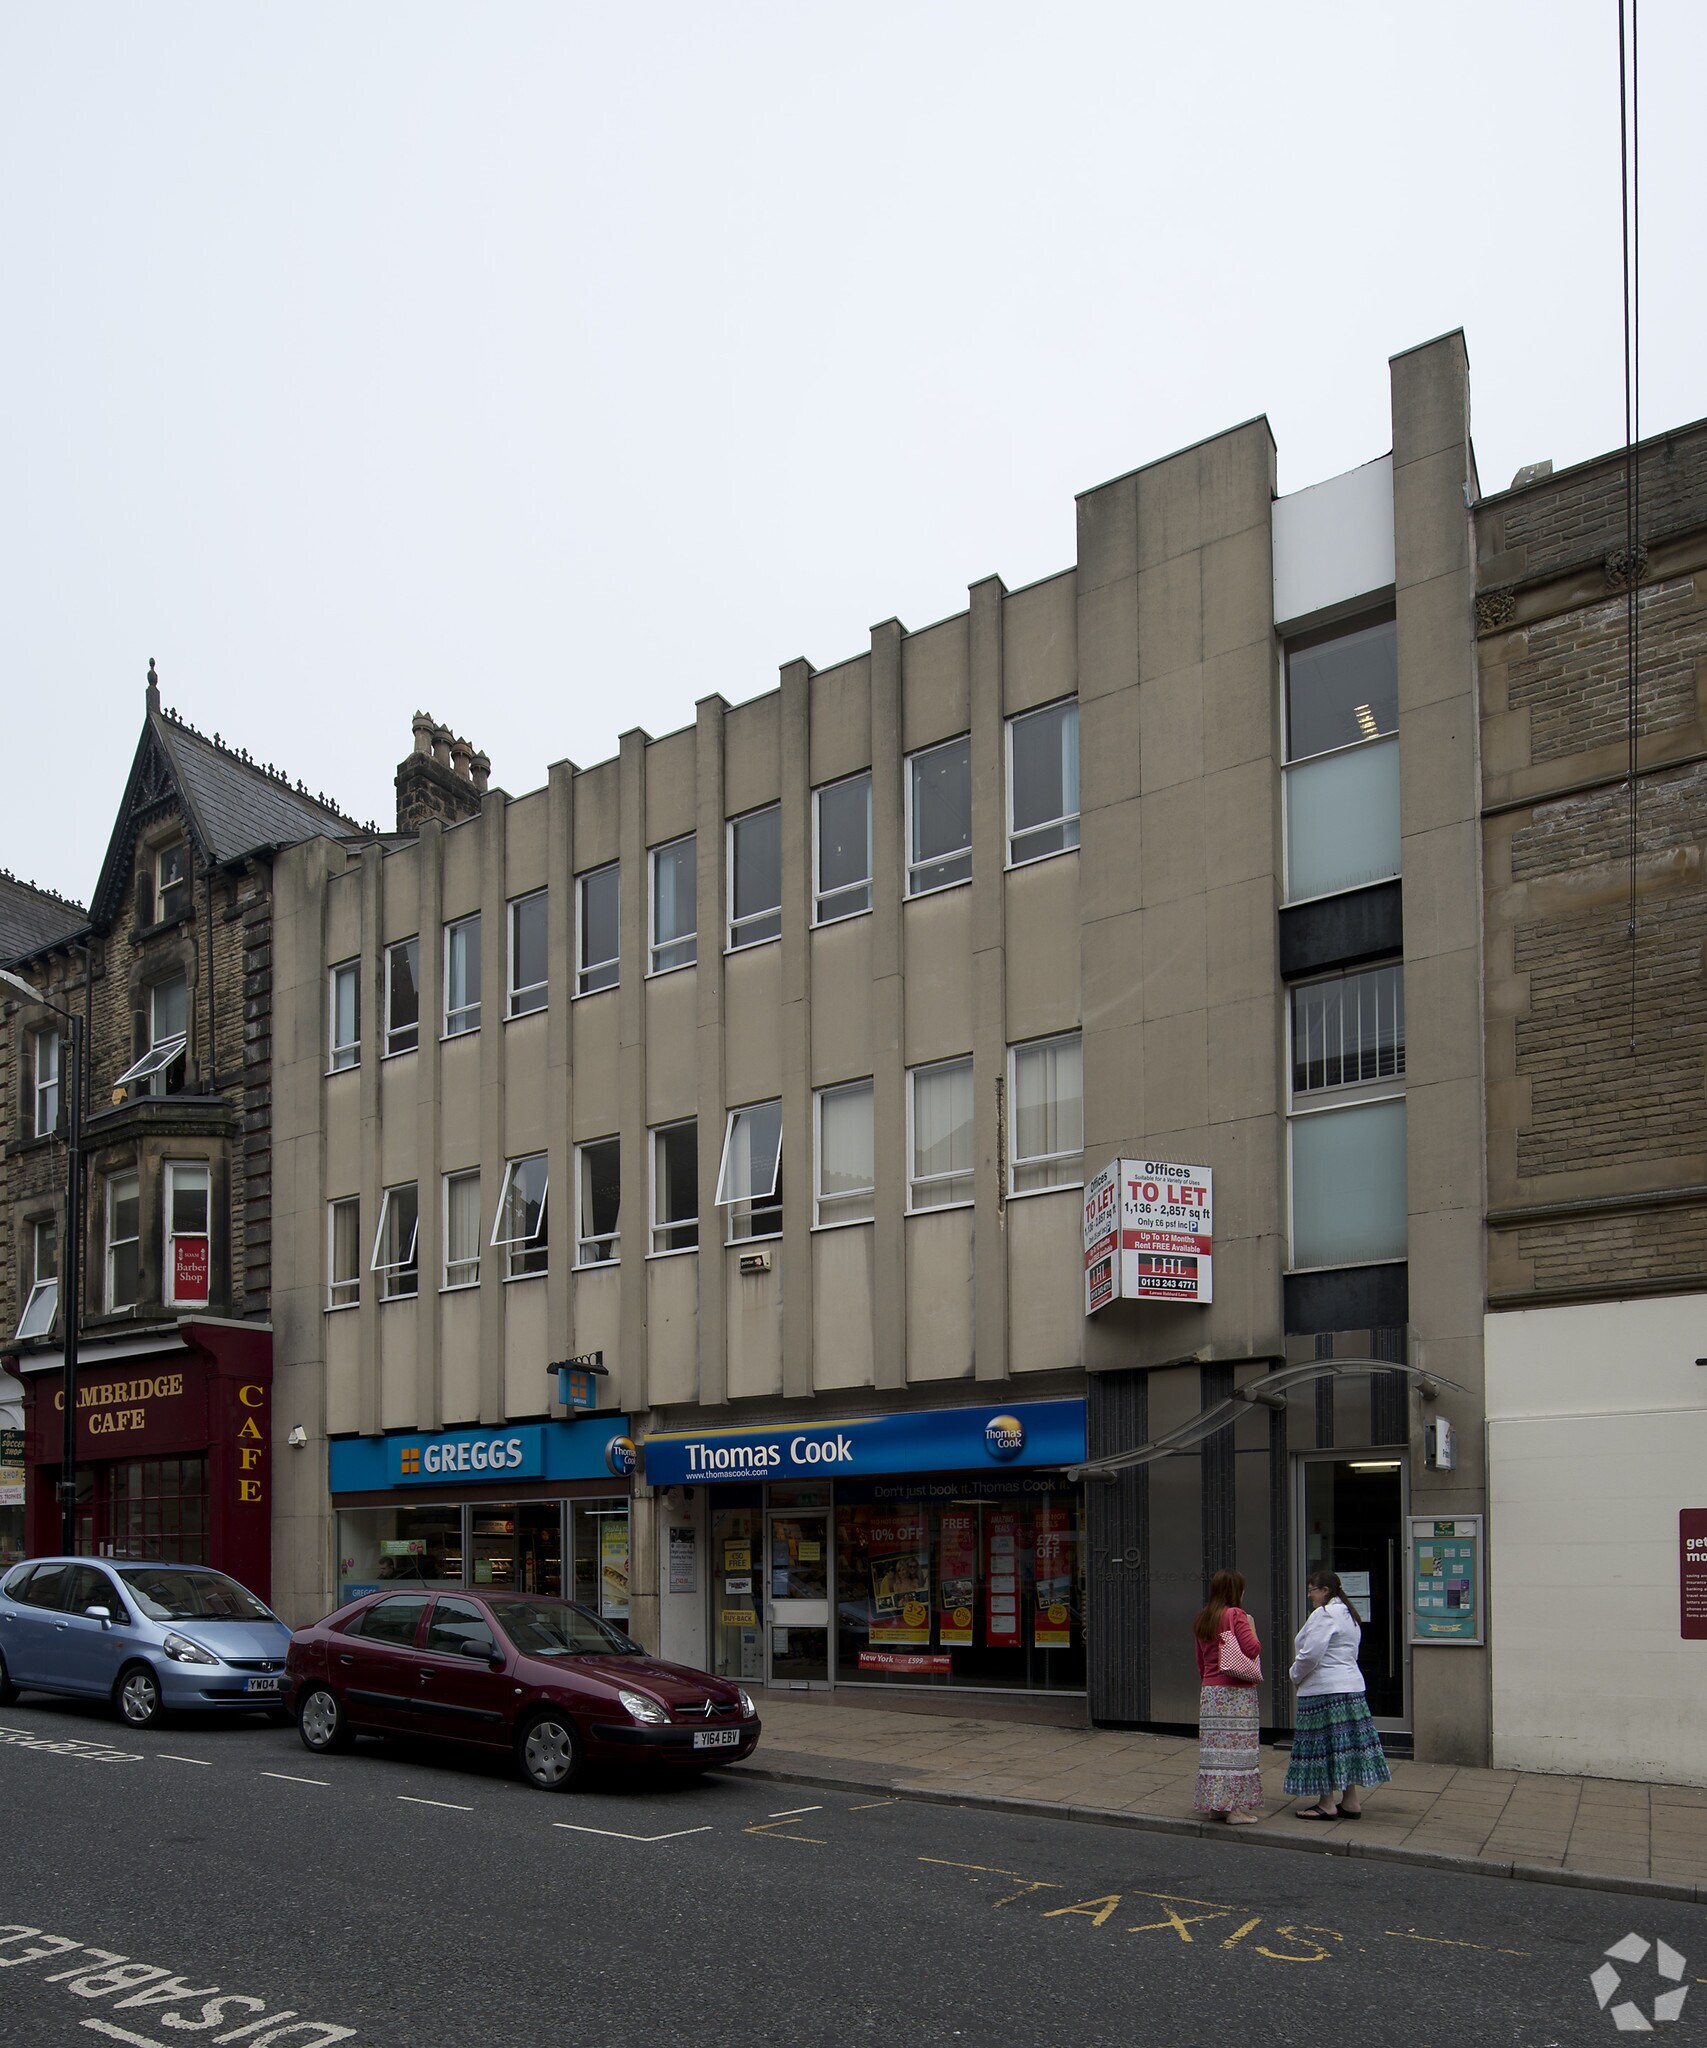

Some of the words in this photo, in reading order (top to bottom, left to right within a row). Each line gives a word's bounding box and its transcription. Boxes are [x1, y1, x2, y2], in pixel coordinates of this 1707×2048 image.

[1144, 1162, 1190, 1178] Offices
[1090, 1172, 1108, 1193] Offices
[1127, 1181, 1159, 1202] TO
[1167, 1184, 1207, 1206] LET
[1085, 1200, 1096, 1223] TO
[1098, 1184, 1115, 1213] LET
[1124, 1202, 1152, 1214] 1,136
[1160, 1204, 1186, 1217] 2,857
[1189, 1209, 1200, 1220] sq
[1202, 1208, 1210, 1219] ft
[1137, 1217, 1154, 1227] Only
[1155, 1218, 1164, 1227] £6
[1165, 1219, 1176, 1229] psf
[1178, 1220, 1188, 1229] inc
[1140, 1232, 1151, 1242] Up
[1152, 1232, 1160, 1241] To
[1171, 1234, 1195, 1243] Months
[1134, 1241, 1151, 1249] Rent
[1152, 1242, 1171, 1251] FREE
[1171, 1243, 1201, 1253] Available
[176, 1262, 207, 1271] Barber
[1150, 1257, 1187, 1275] LHL
[179, 1272, 203, 1284] Shop
[1092, 1264, 1107, 1285] LHL
[1141, 1278, 1161, 1287] 0113
[1162, 1279, 1177, 1288] 243
[1177, 1280, 1196, 1289] 4771
[88, 1408, 145, 1435] CAFE
[985, 1429, 1022, 1439] Thomas
[2, 1440, 25, 1448] SOCCER
[237, 1385, 264, 1502] CAFE
[997, 1437, 1022, 1448] Cook
[5, 1448, 23, 1456] SHOP
[424, 1438, 523, 1473] GREGGS
[685, 1443, 781, 1470] Thomas
[790, 1433, 854, 1465] Cook
[3, 1470, 19, 1479] SHOP
[686, 1467, 768, 1480] www.thomascook.com
[874, 1484, 904, 1498] Don't
[904, 1483, 927, 1499] just
[929, 1482, 959, 1496] book
[972, 1480, 1020, 1494] Thomas
[1023, 1478, 1057, 1492] Cook
[942, 1517, 970, 1529] FREE
[870, 1528, 894, 1541] 10%
[897, 1527, 924, 1541] OFF
[1037, 1534, 1060, 1546] £75
[1037, 1546, 1060, 1559] OFF
[1092, 1546, 1141, 1570] 7-9
[728, 1559, 747, 1567] FREE
[956, 1609, 970, 1621] 0%
[870, 1629, 876, 1640] 3
[941, 1631, 947, 1640] 3
[1036, 1632, 1042, 1642] 3
[860, 1653, 876, 1662] New
[877, 1654, 894, 1664] York
[907, 1657, 924, 1665] £599
[721, 1730, 738, 1744] EBV
[992, 1878, 1344, 1963] TAXIS
